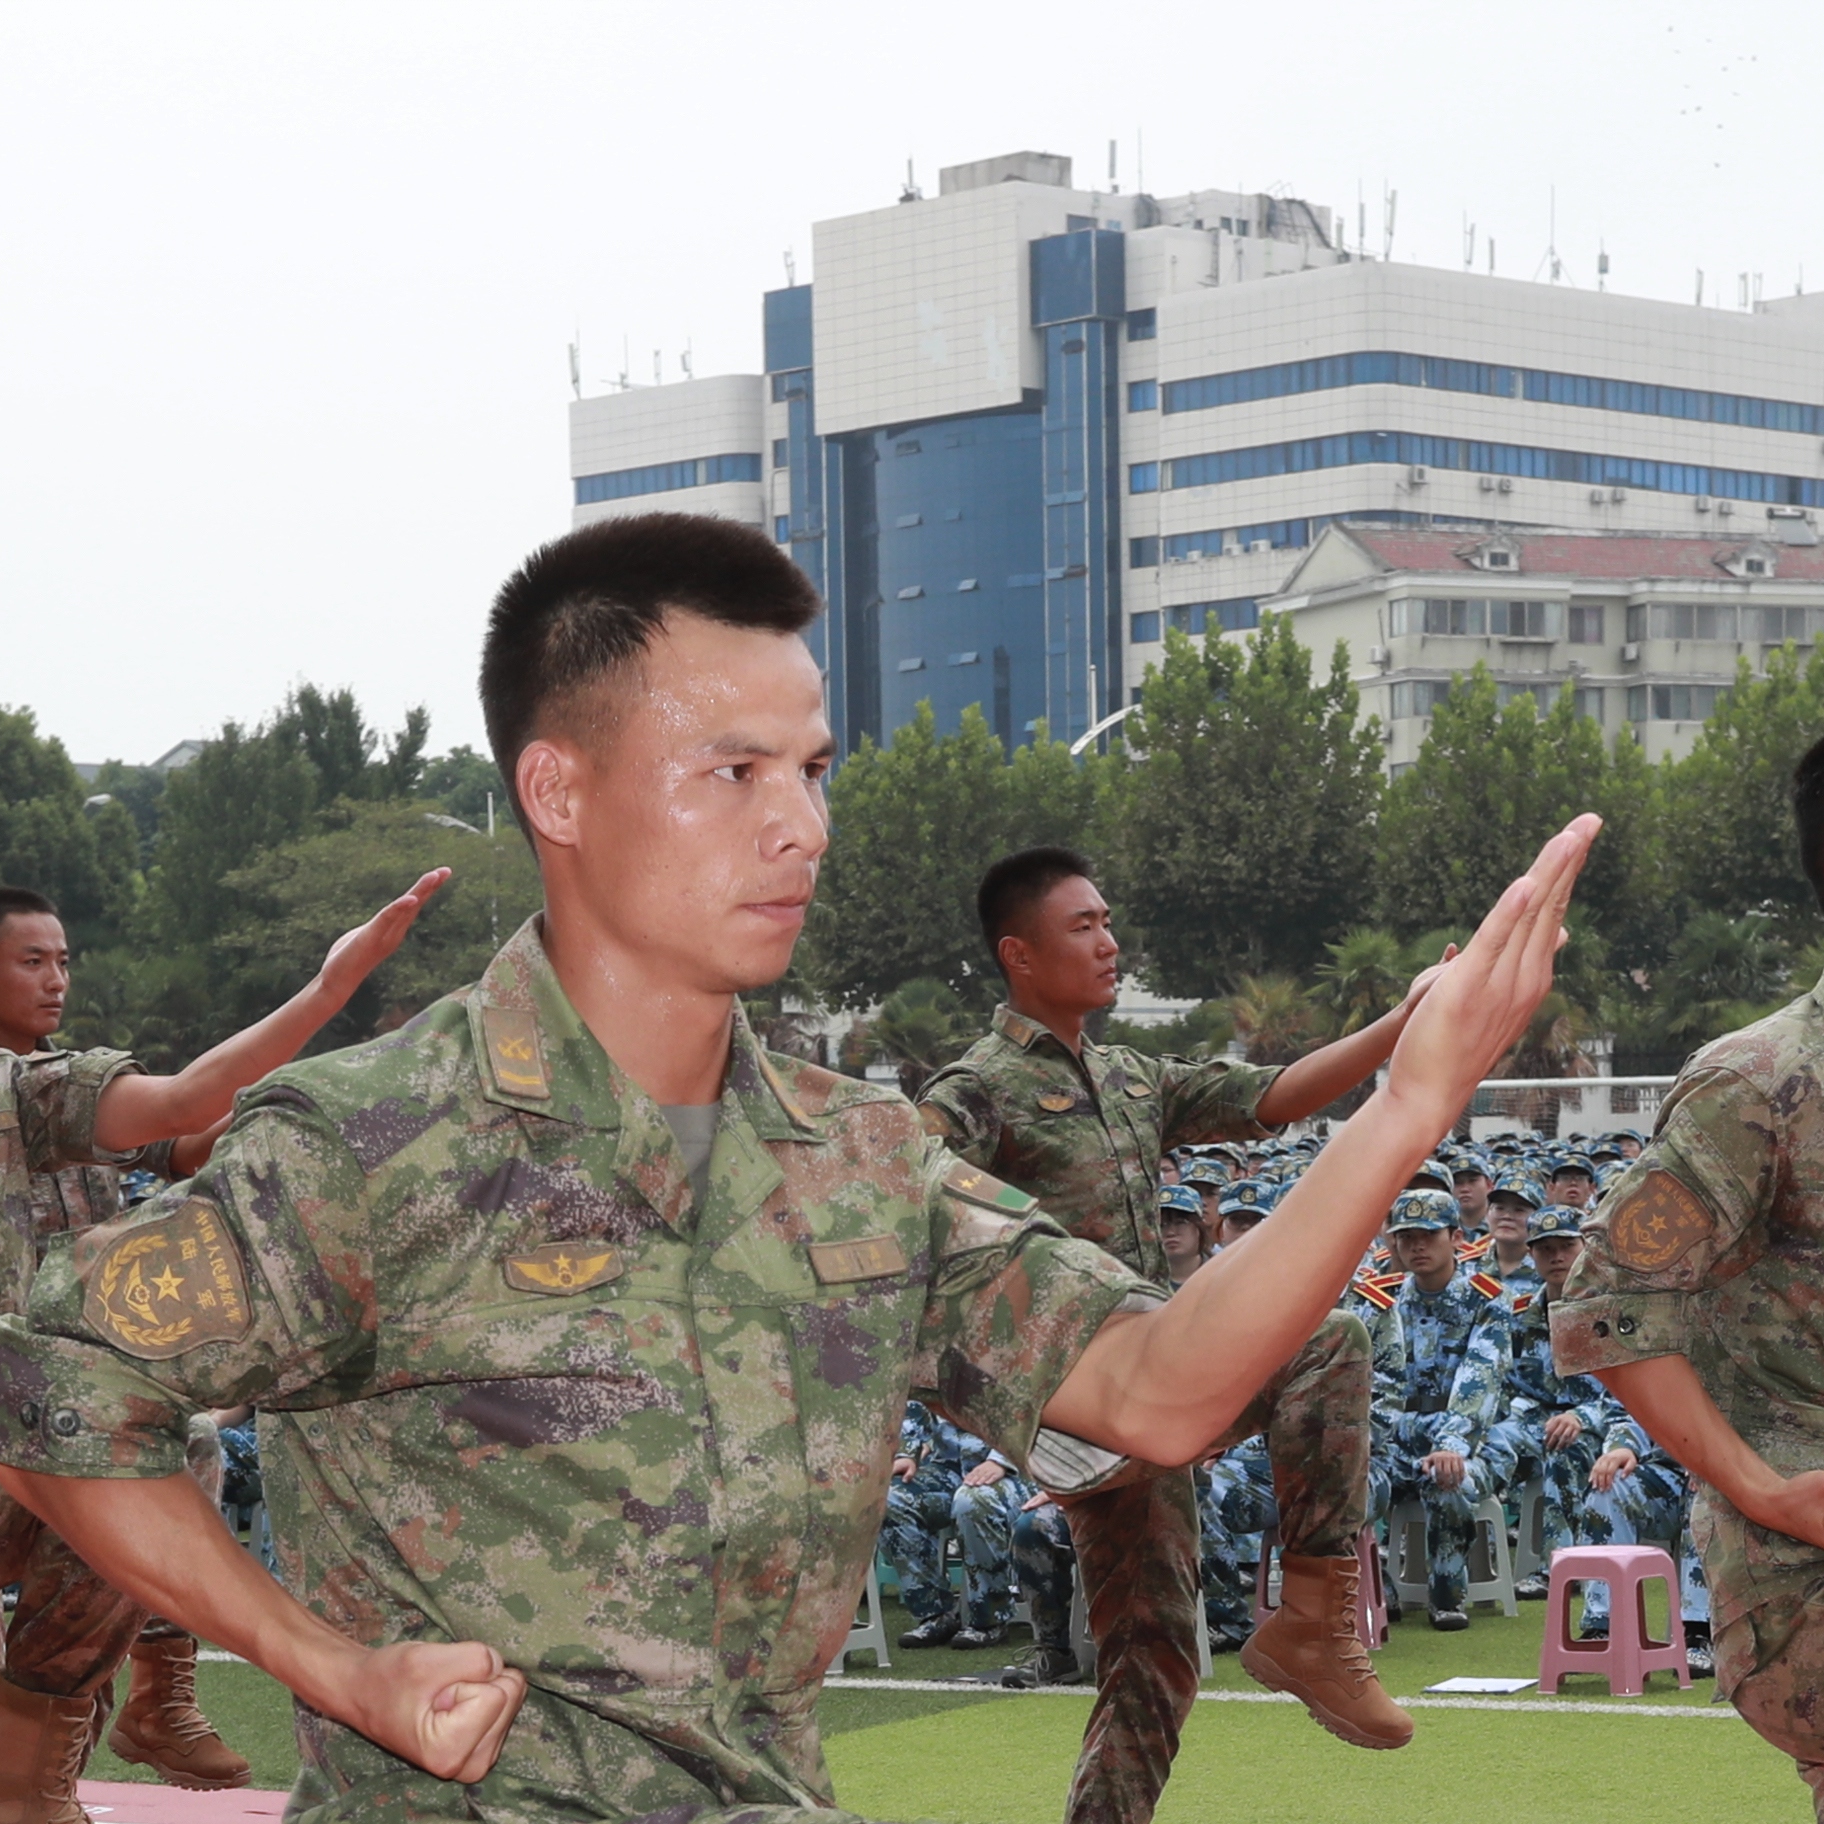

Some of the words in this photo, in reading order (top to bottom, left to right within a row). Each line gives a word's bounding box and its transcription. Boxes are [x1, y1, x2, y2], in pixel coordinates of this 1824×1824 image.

[195, 1210, 243, 1323] 中国人民解放军
